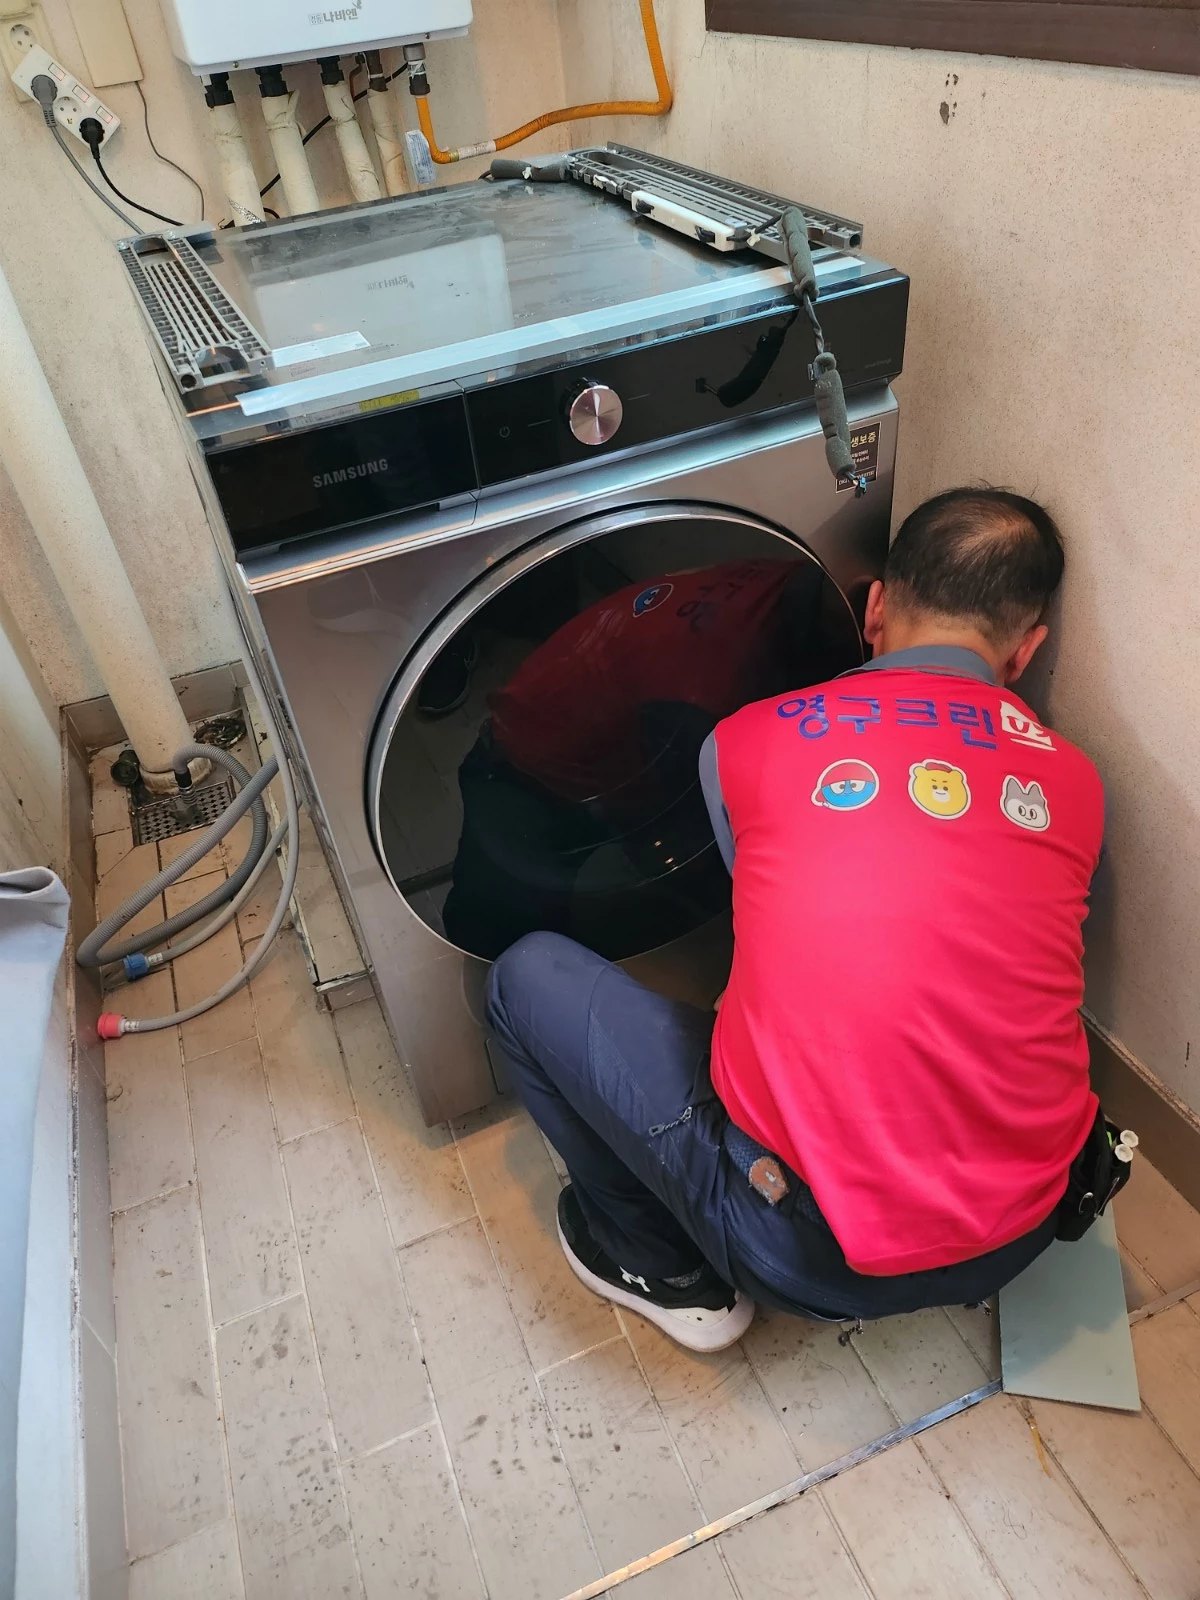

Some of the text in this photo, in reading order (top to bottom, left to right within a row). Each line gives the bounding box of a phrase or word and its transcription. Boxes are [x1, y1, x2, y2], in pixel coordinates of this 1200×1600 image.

[850, 431, 876, 448] 생보증
[312, 458, 389, 488] SAMSUNG
[776, 693, 997, 751] 영구크린
